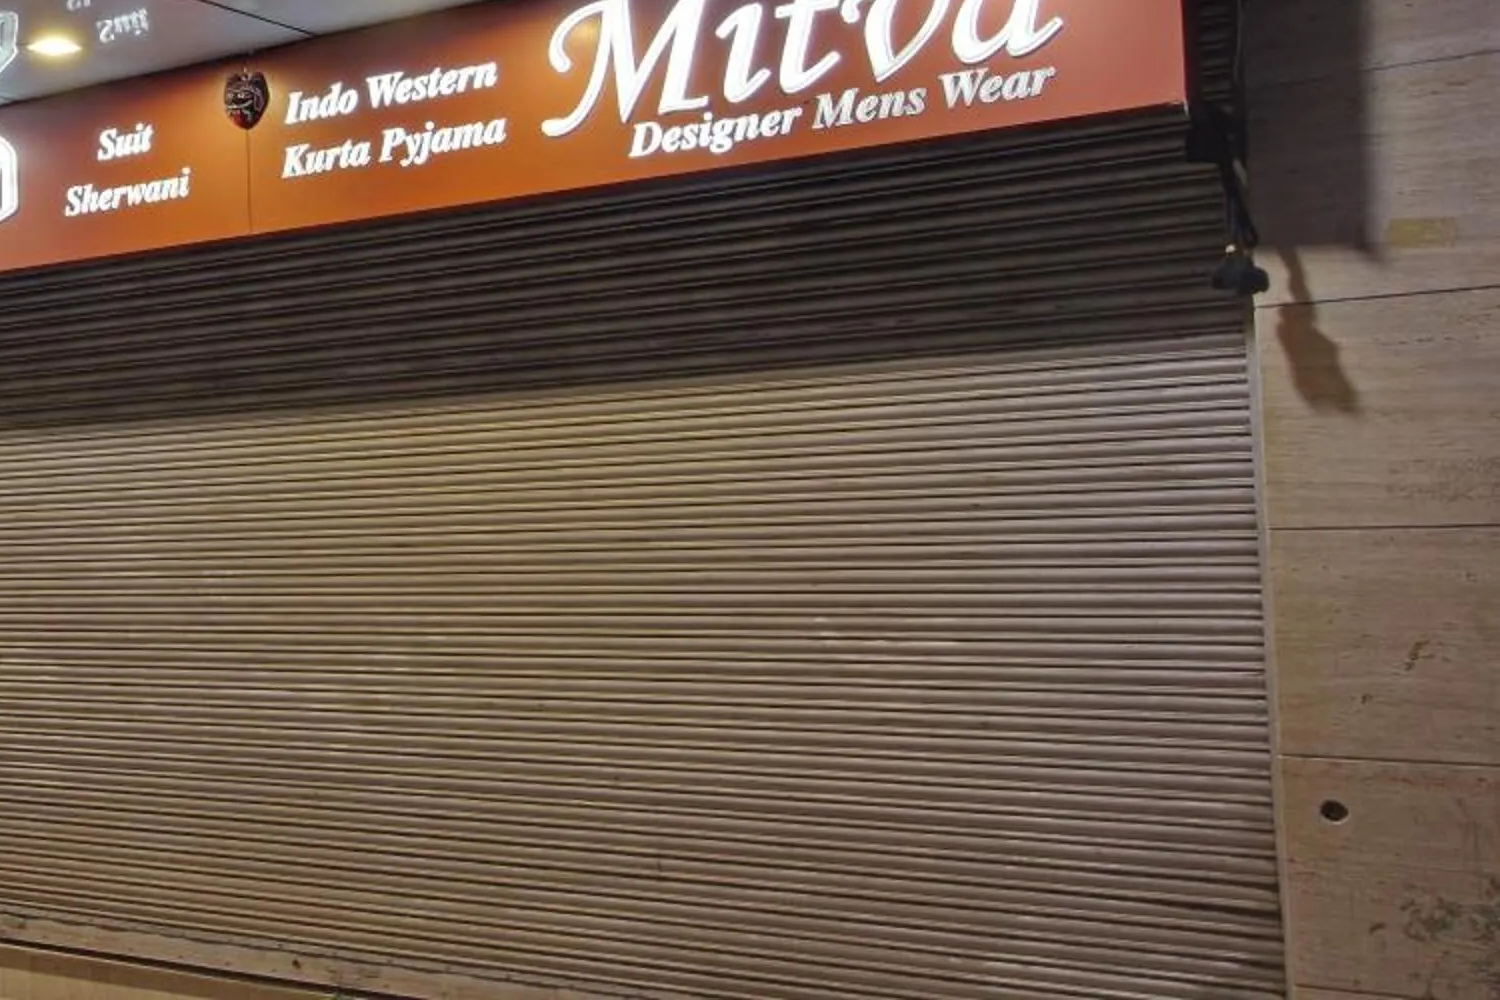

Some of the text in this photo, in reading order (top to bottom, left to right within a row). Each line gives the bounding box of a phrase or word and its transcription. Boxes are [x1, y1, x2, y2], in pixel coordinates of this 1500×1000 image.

[283, 60, 499, 126] Indo Western
[627, 64, 1057, 159] Designer Mens Wear
[97, 122, 154, 162] Suit
[281, 116, 508, 180] Kurta Pyjama
[64, 167, 191, 217] Sherwani
